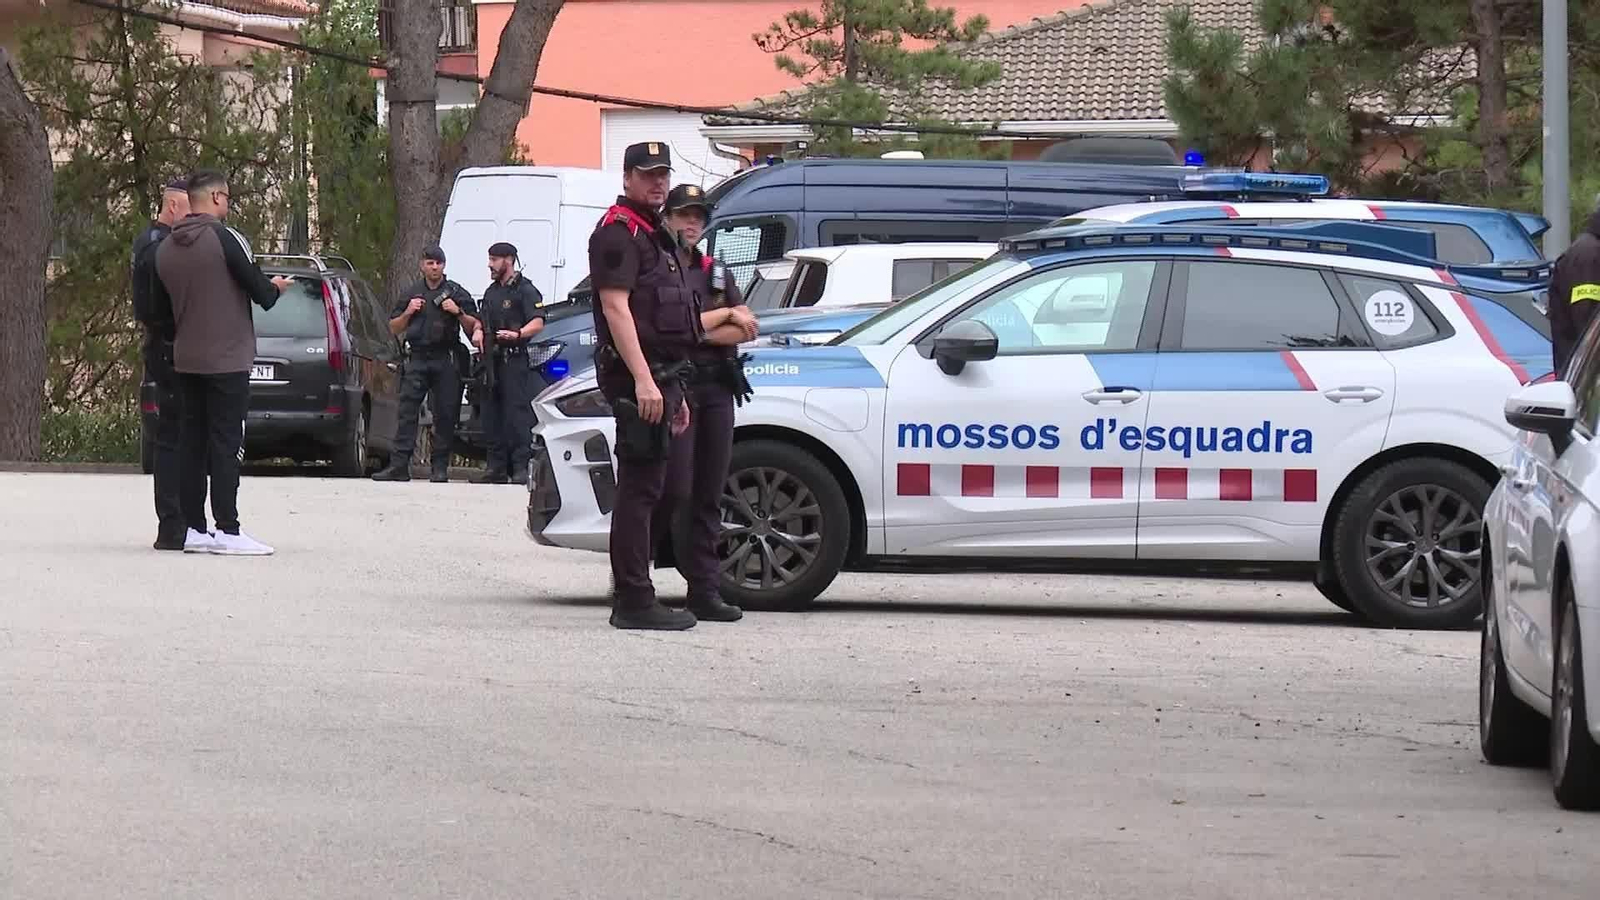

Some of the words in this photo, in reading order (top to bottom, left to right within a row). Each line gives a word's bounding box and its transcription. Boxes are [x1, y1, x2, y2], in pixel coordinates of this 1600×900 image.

[1374, 302, 1405, 317] 112
[743, 363, 799, 377] policia
[897, 422, 1060, 449] mossos
[1080, 418, 1313, 458] d'esquadra
